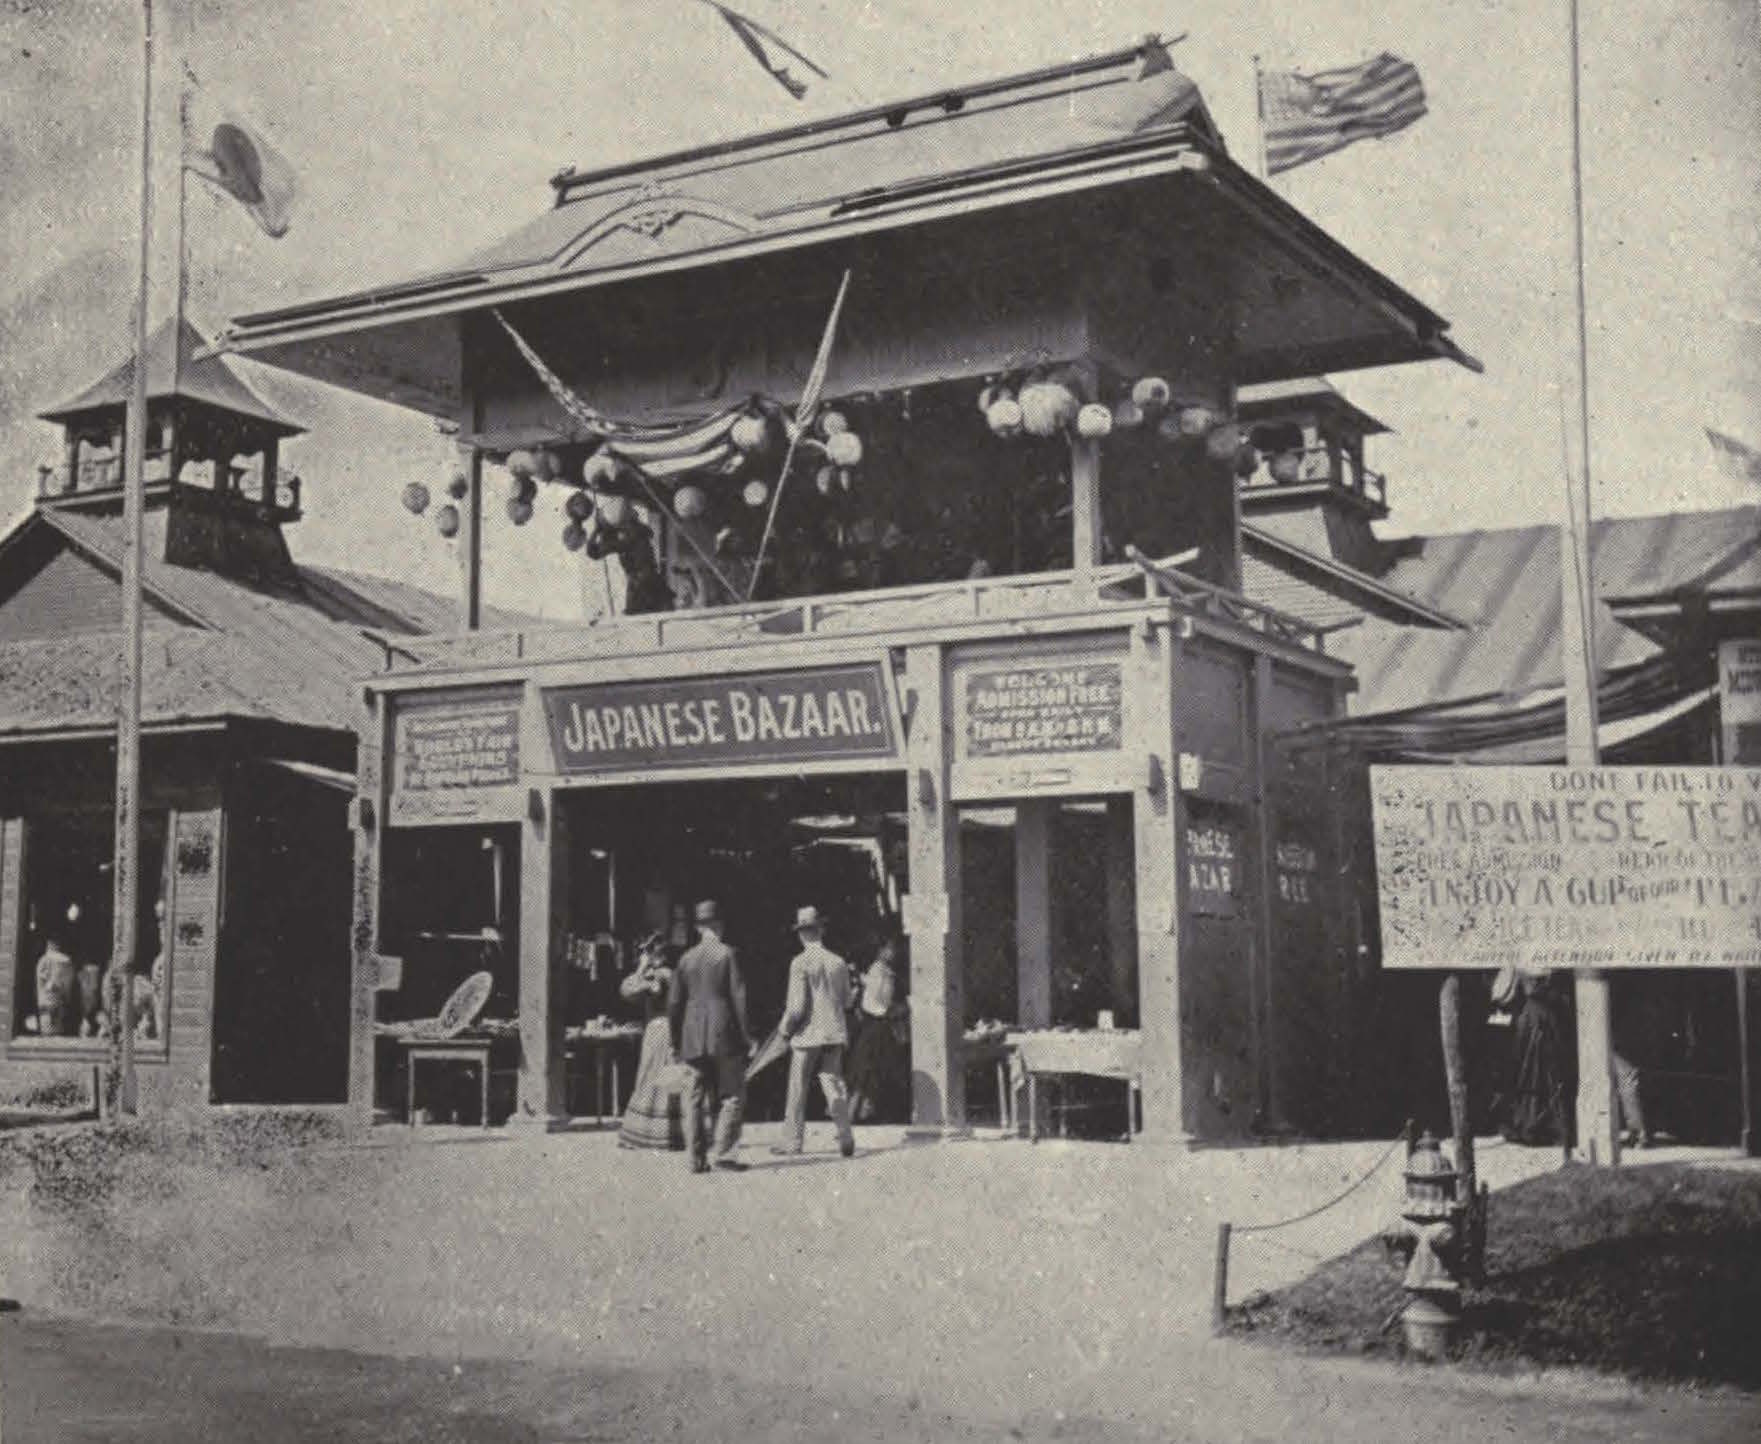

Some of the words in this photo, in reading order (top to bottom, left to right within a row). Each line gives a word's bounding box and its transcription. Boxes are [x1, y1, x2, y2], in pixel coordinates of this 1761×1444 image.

[564, 700, 725, 753] JAPANESE
[729, 689, 883, 743] BAZAAR.
[1635, 771, 1694, 792] FAIL
[1424, 799, 1650, 844] JAPANESE
[1533, 876, 1555, 906] A
